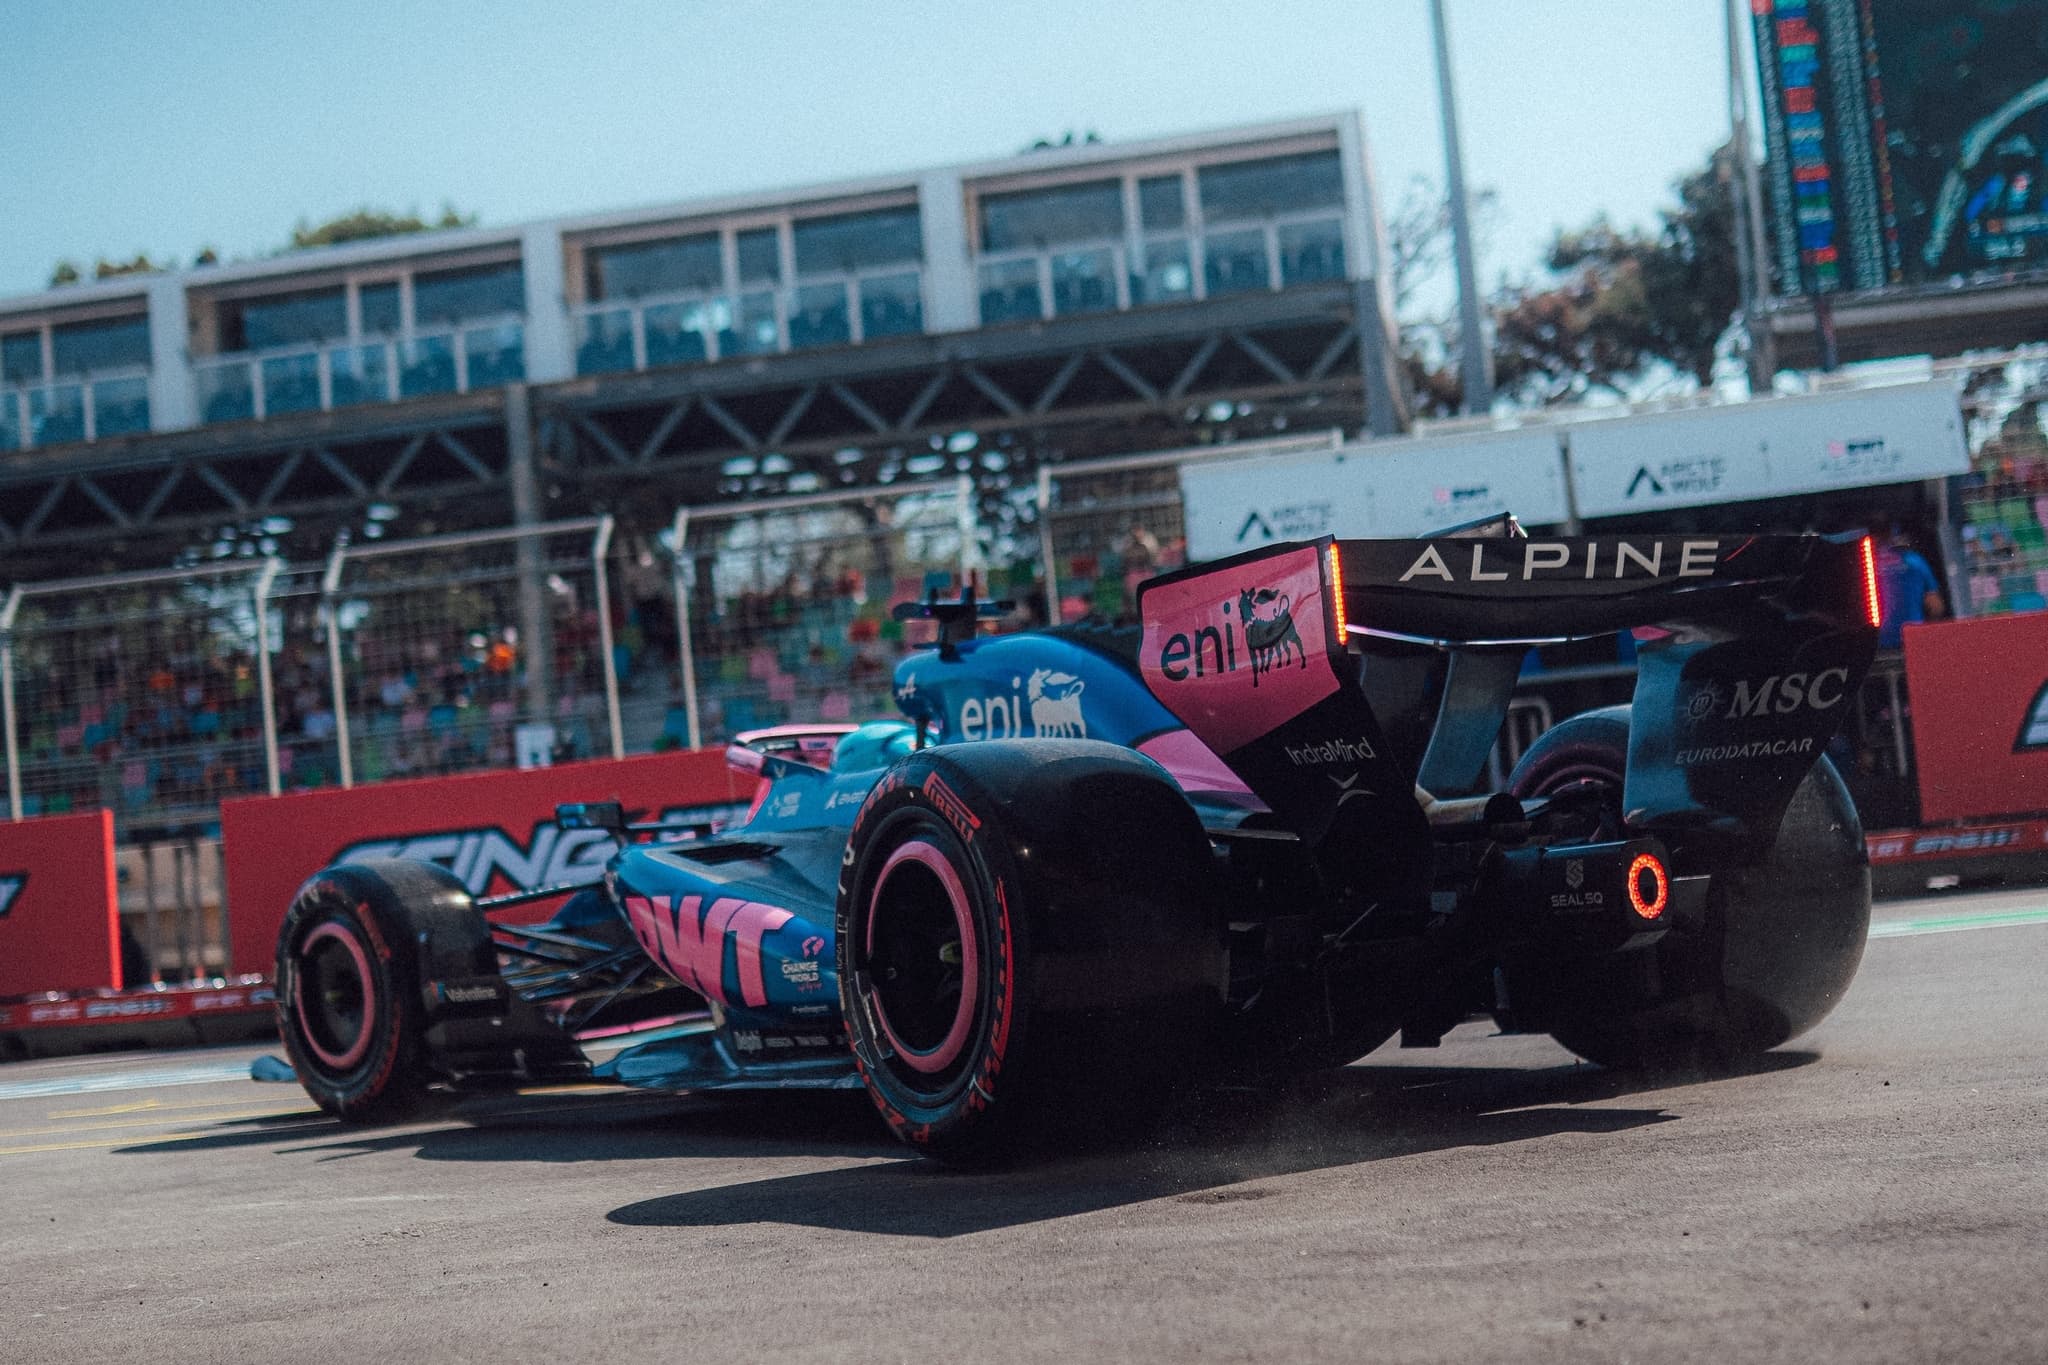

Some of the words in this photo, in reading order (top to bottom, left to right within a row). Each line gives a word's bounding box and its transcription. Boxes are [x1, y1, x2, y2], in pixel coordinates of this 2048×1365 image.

[1398, 541, 1719, 581] ALPINE
[1160, 602, 1236, 682] eni
[960, 675, 1023, 741] eni
[1724, 667, 1848, 719] MSC
[1284, 736, 1376, 766] IndraMind
[1675, 738, 1812, 765] EURODATACAR
[923, 770, 982, 844] PIRELLI
[330, 823, 618, 897] ING
